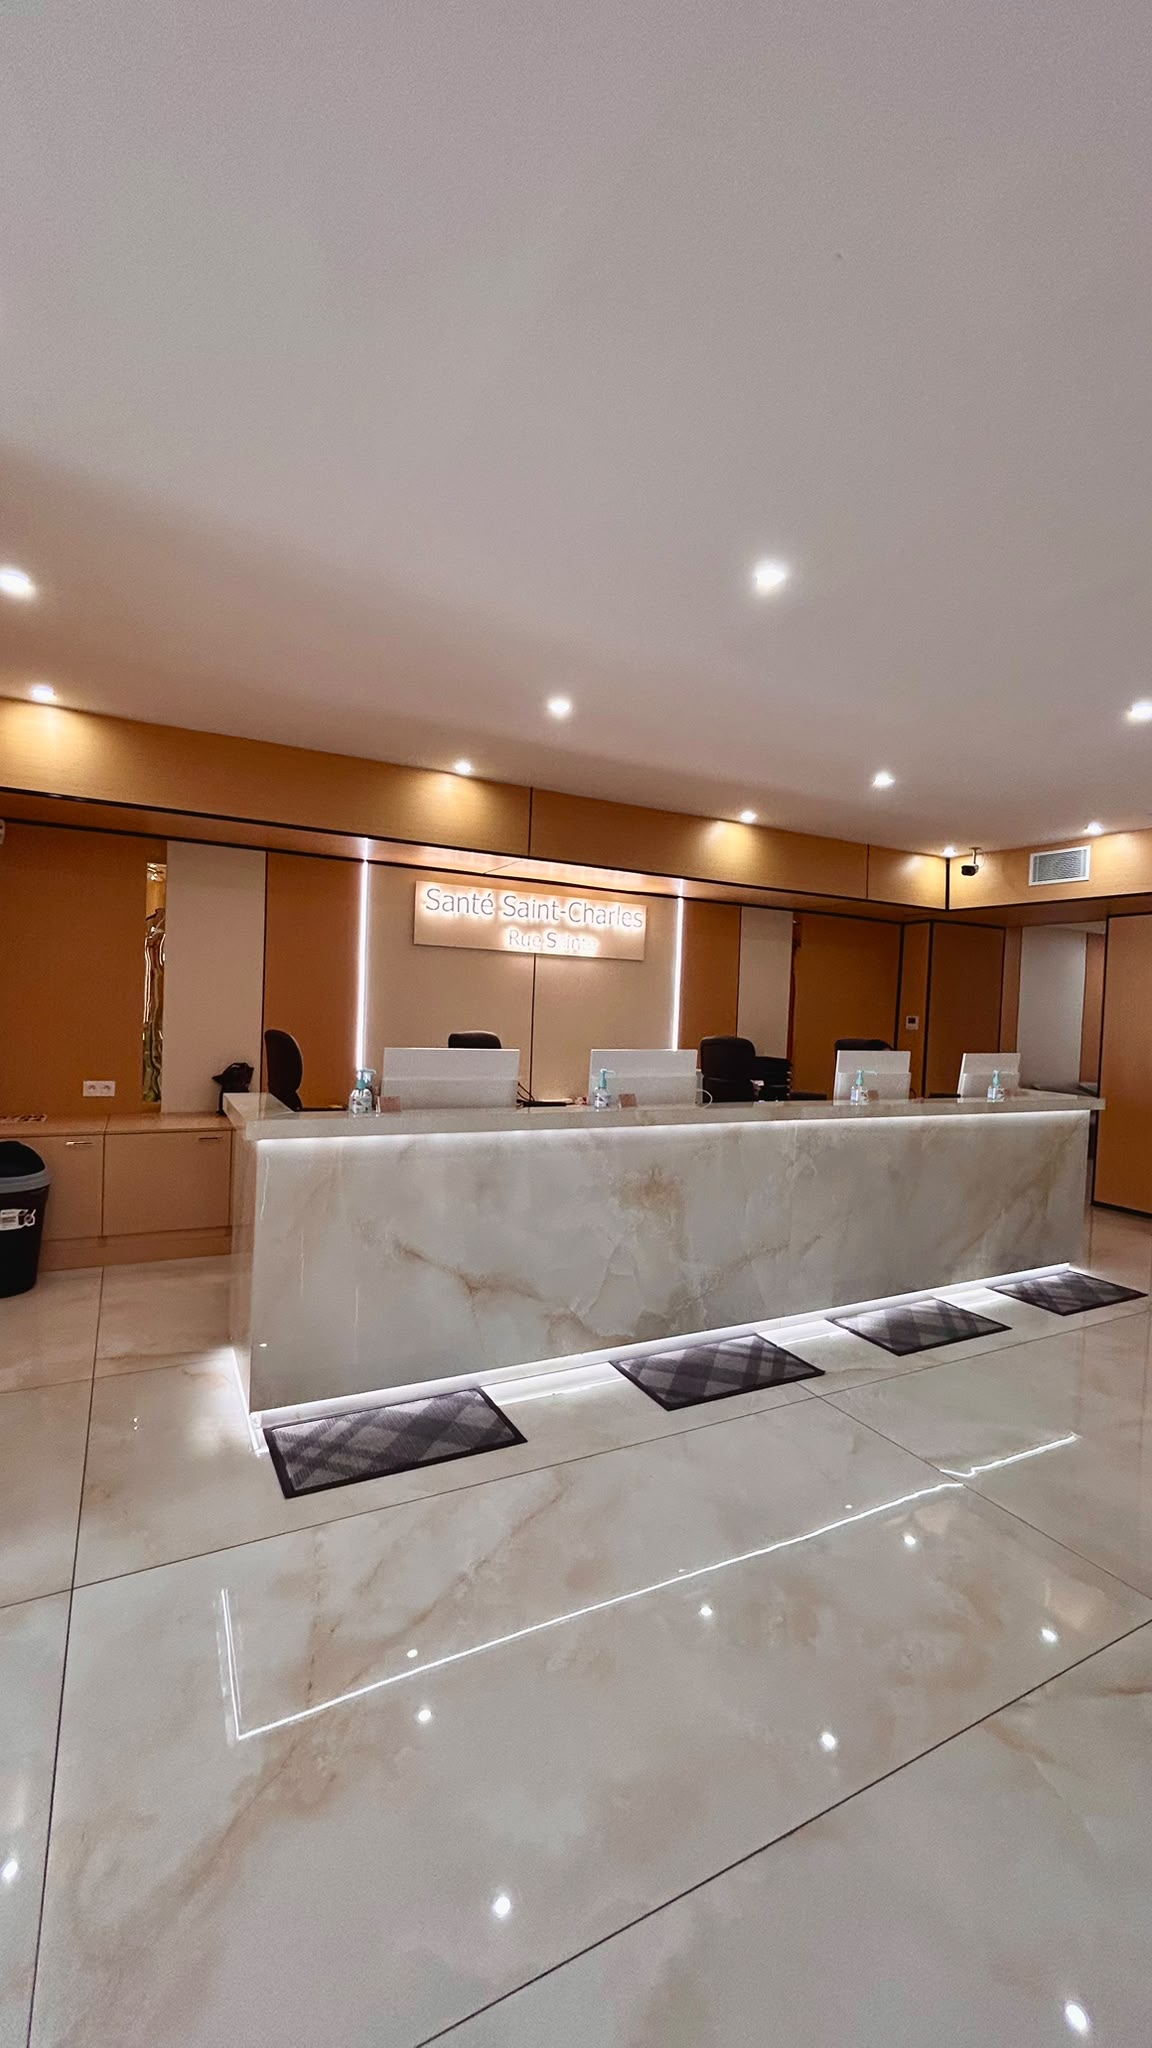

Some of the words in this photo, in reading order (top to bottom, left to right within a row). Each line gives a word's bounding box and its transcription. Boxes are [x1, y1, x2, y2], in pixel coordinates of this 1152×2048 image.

[425, 888, 494, 916] Santé
[502, 895, 643, 928] Saint-Charles
[508, 929, 542, 948] Rue
